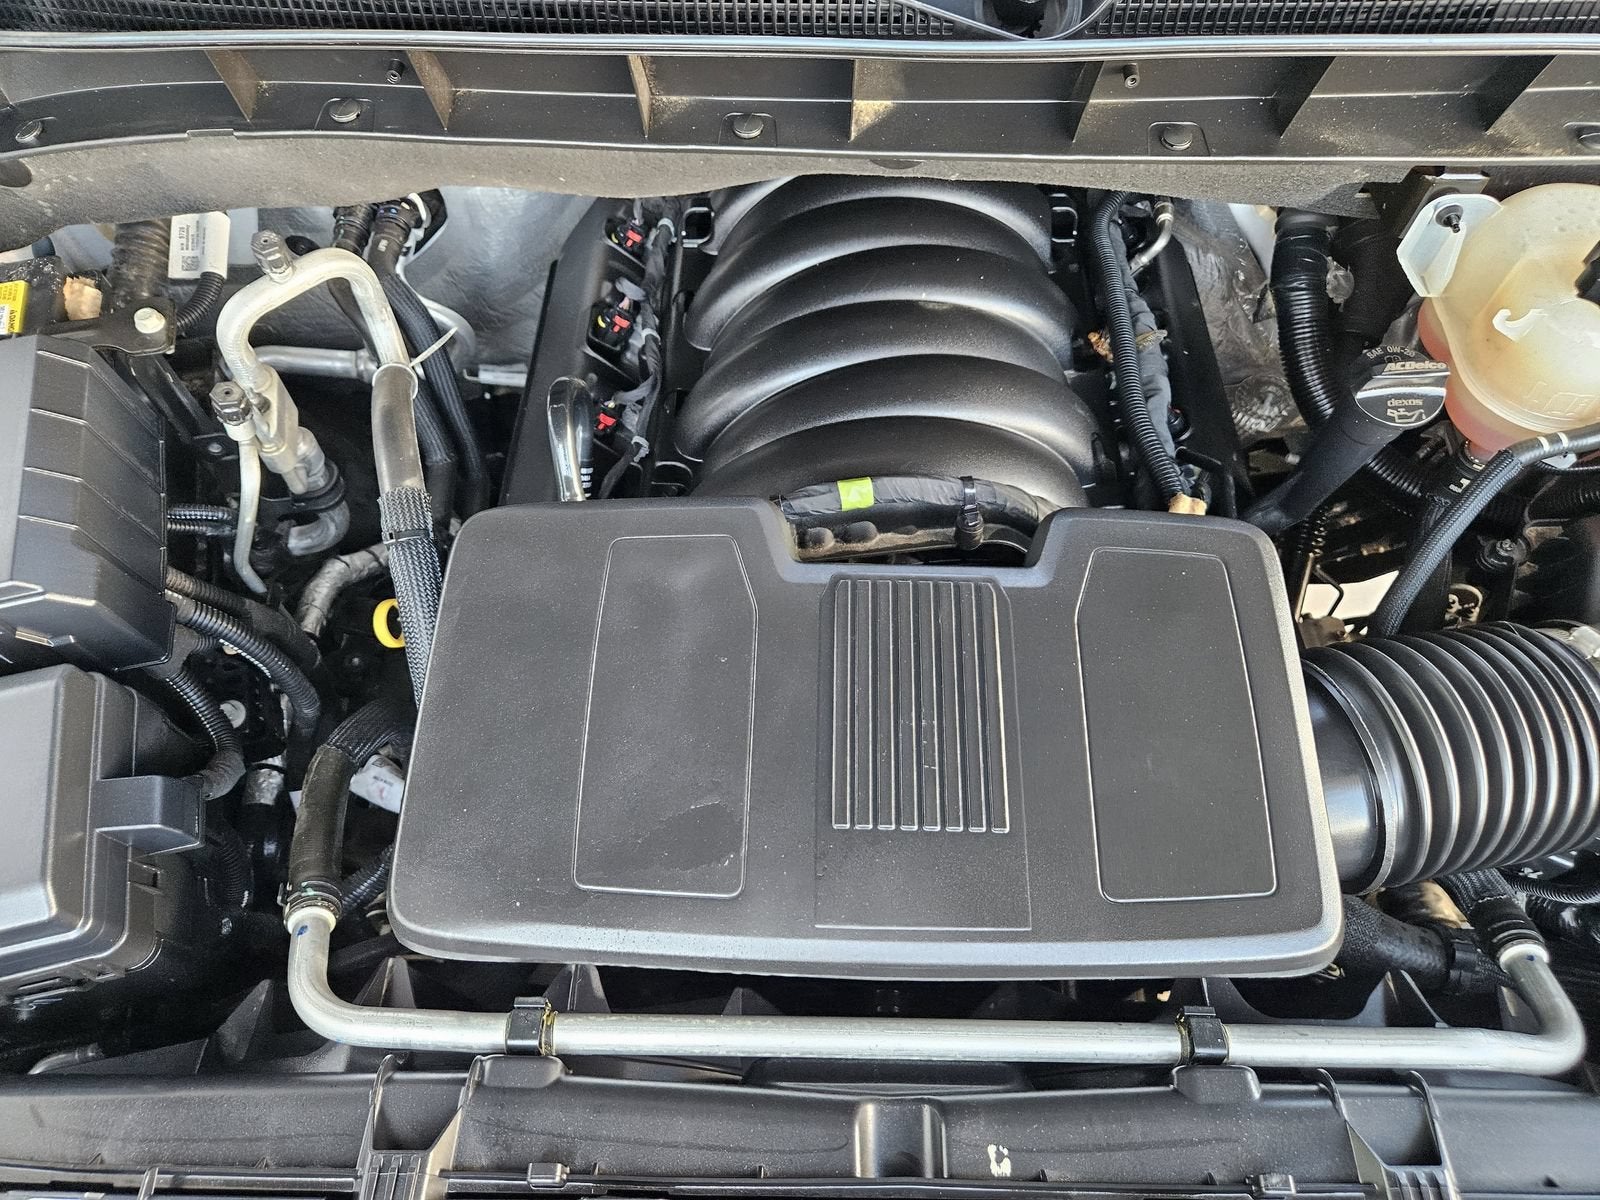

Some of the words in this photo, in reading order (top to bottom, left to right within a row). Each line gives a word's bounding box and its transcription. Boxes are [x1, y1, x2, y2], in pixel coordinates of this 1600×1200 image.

[1366, 347, 1384, 359] SAE
[1384, 361, 1447, 372] ACDelco
[1387, 398, 1424, 407] dexos
